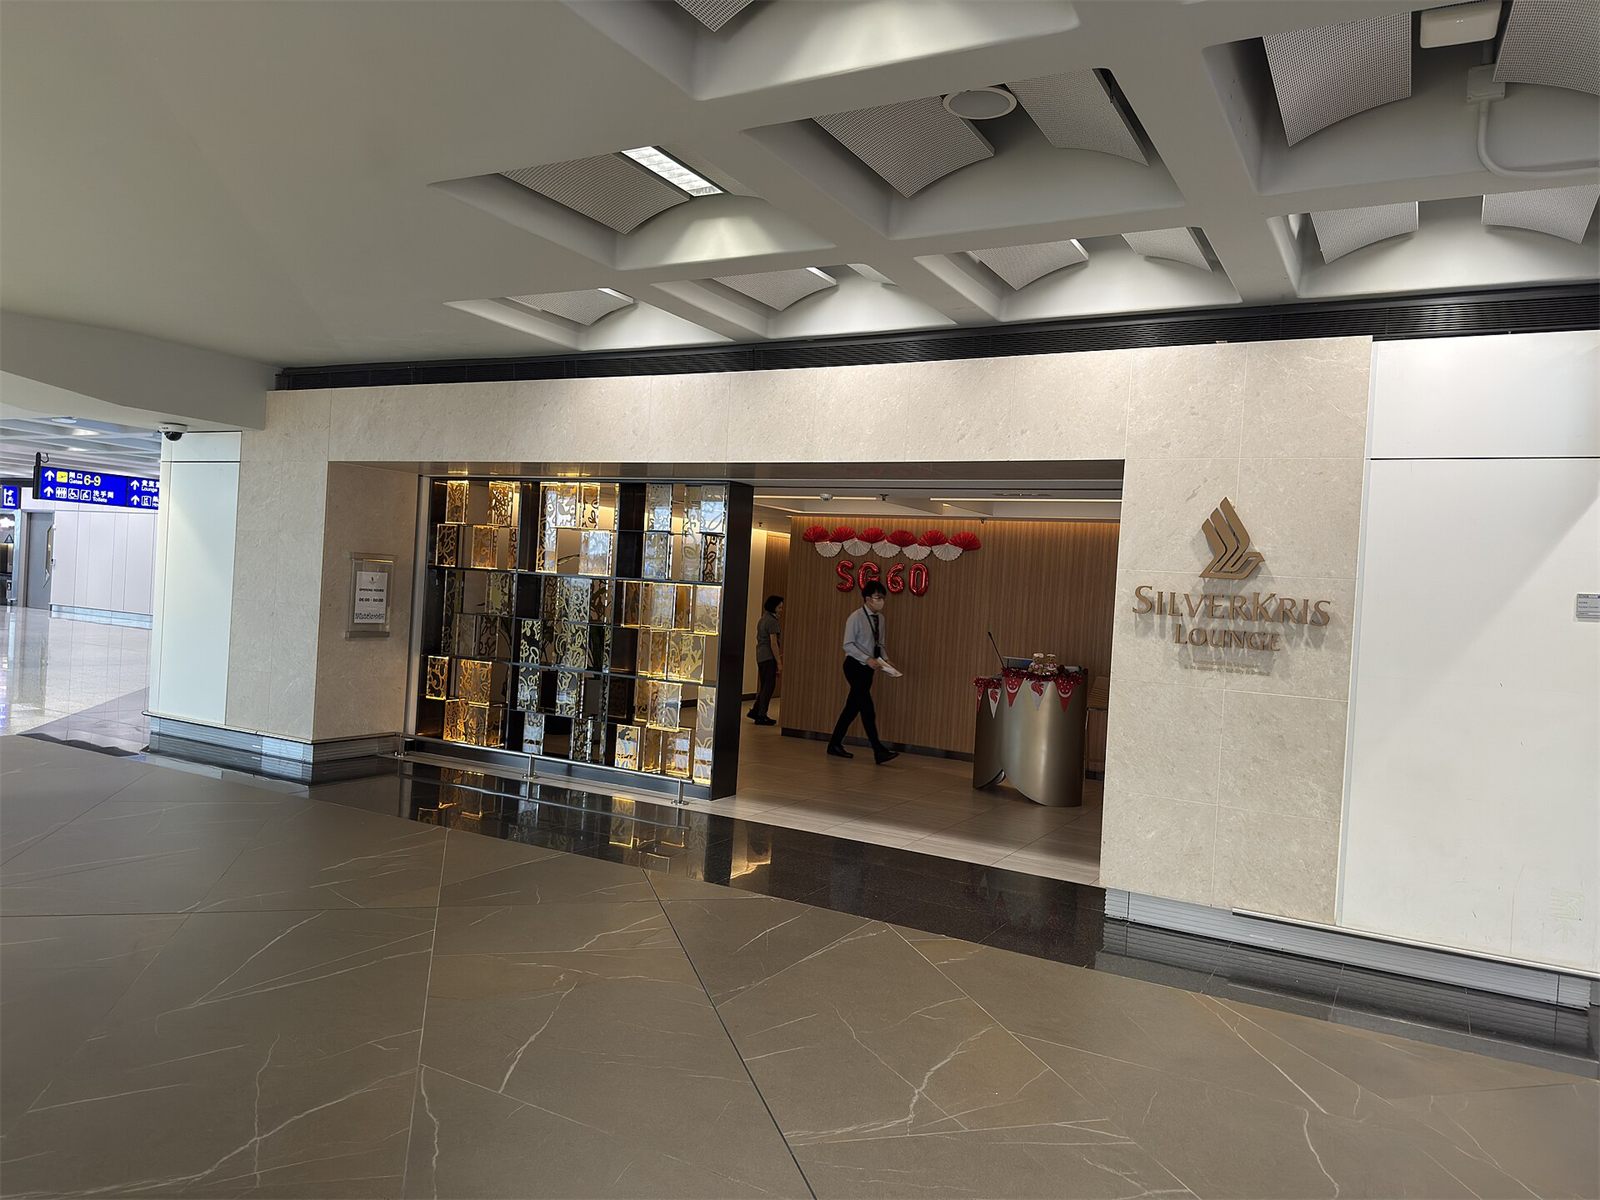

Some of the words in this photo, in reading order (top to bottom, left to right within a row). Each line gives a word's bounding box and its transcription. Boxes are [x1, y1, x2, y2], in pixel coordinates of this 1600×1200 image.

[84, 475, 101, 486] 6-9
[836, 560, 929, 597] SG60
[1132, 585, 1331, 627] SILVERKRIS
[1174, 623, 1281, 652] LOUNGE
